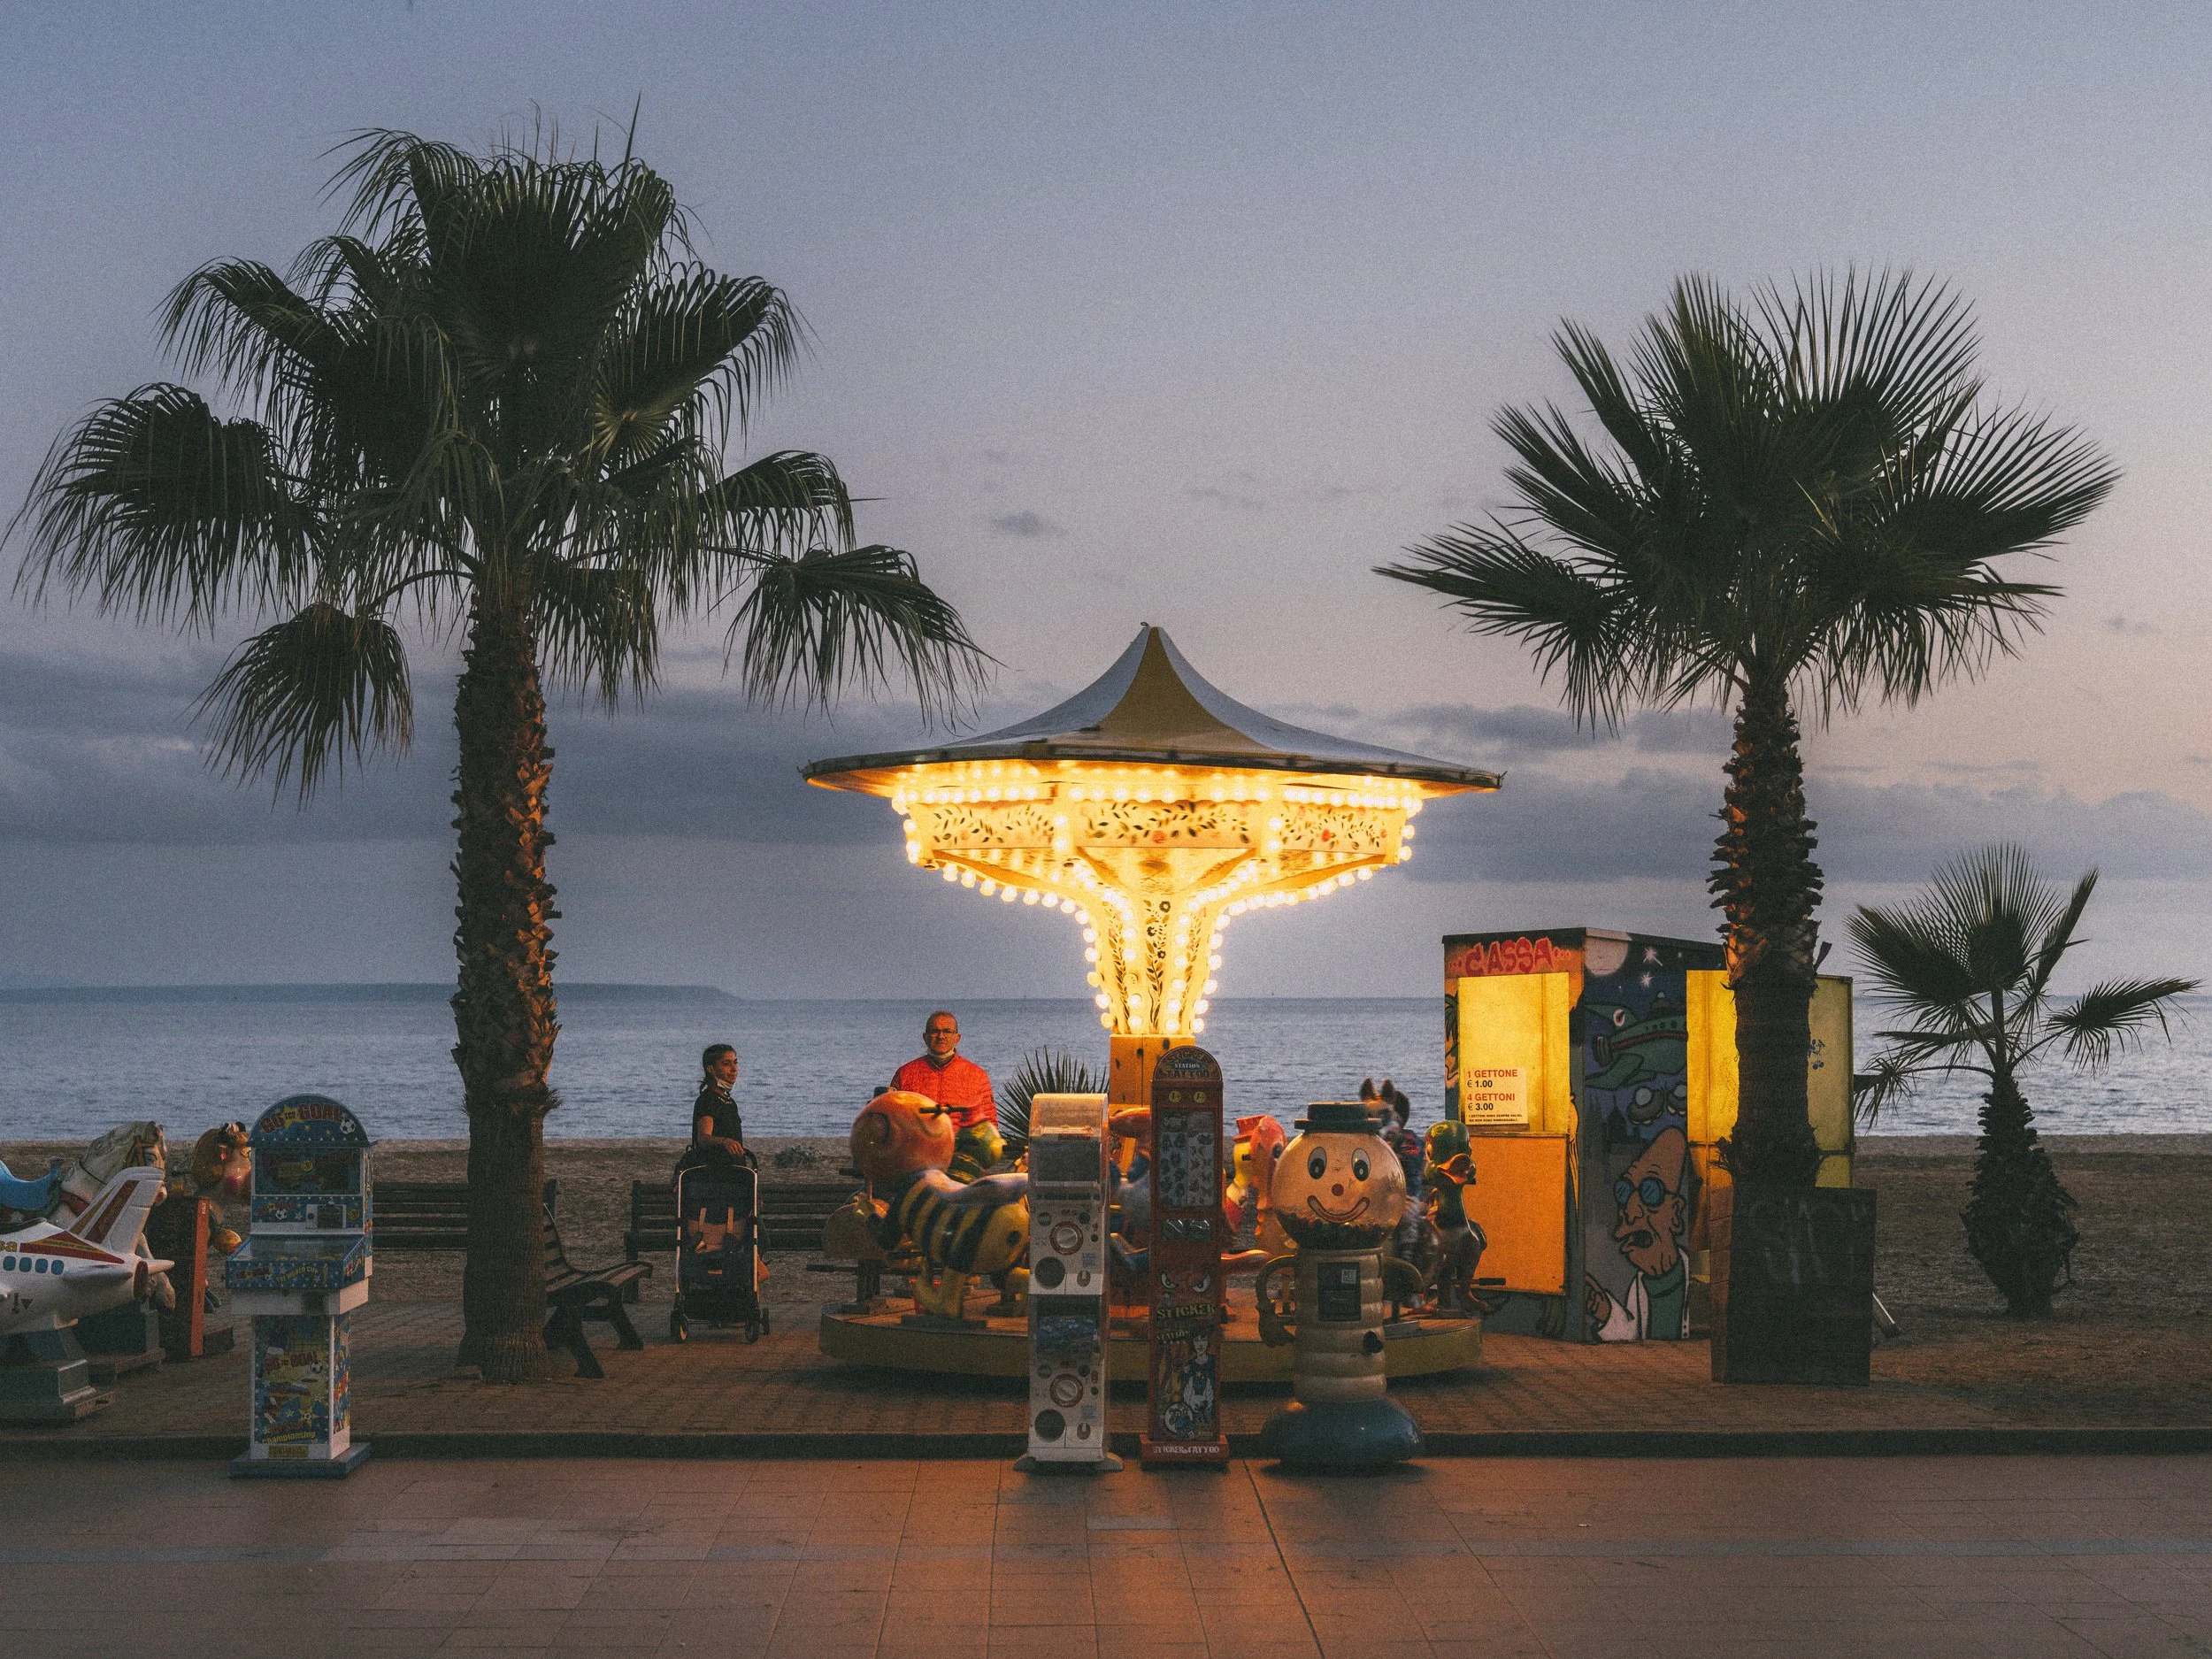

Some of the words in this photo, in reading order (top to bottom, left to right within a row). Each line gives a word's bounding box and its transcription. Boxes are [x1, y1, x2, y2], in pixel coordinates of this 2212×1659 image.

[1475, 1093, 1516, 1102] GETTONI
[297, 1103, 342, 1123] GOAL
[1156, 1303, 1215, 1319] STICKER
